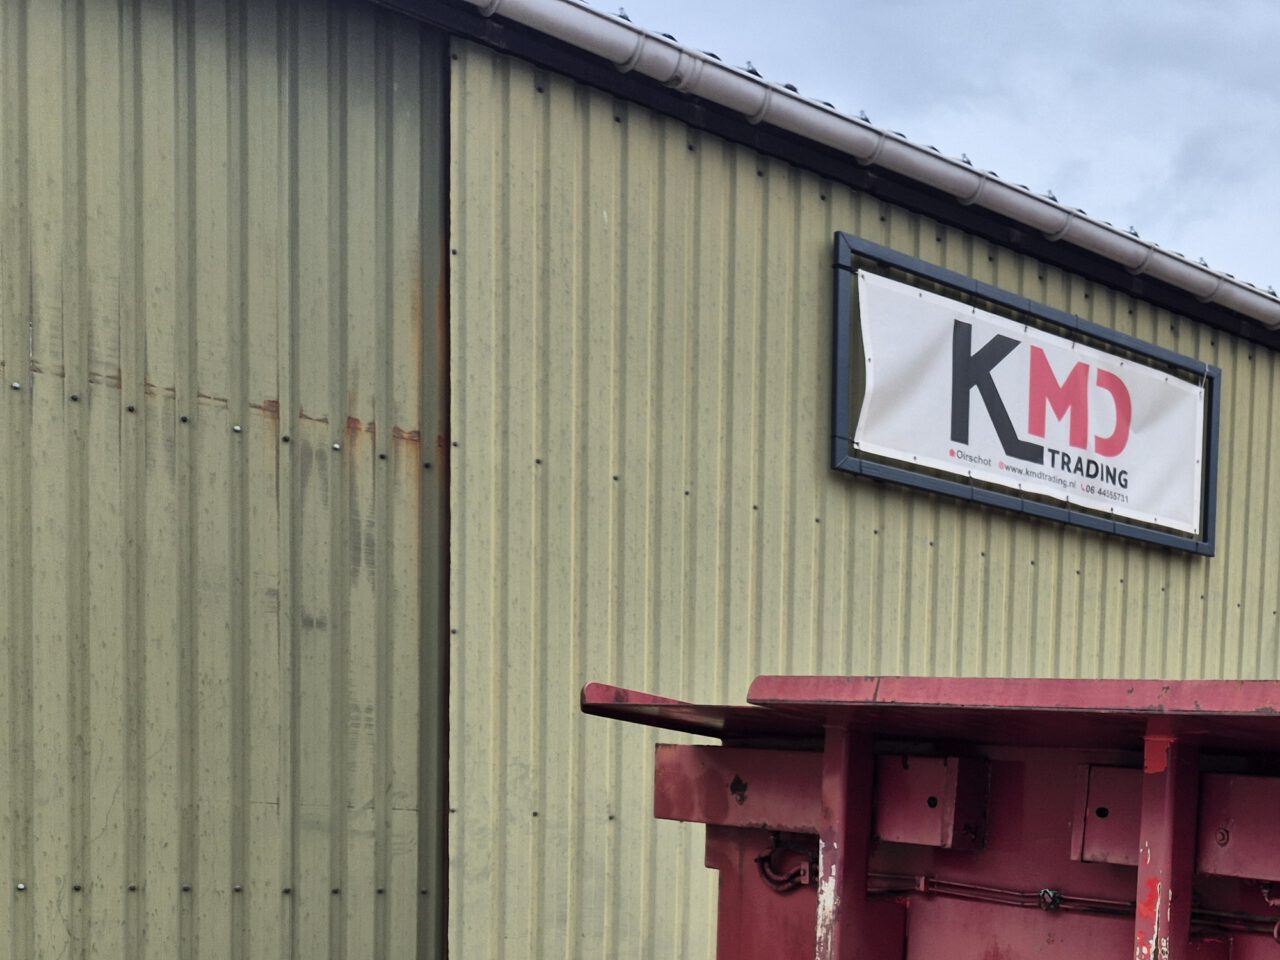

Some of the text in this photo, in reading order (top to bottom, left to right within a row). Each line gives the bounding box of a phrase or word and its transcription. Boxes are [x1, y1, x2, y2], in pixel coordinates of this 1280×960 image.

[951, 319, 1132, 463] KMD
[956, 450, 992, 467] Oirschot
[1005, 464, 1077, 489] www.kmdtrading.nl
[1085, 484, 1096, 494] 06
[1047, 448, 1129, 489] TRADING
